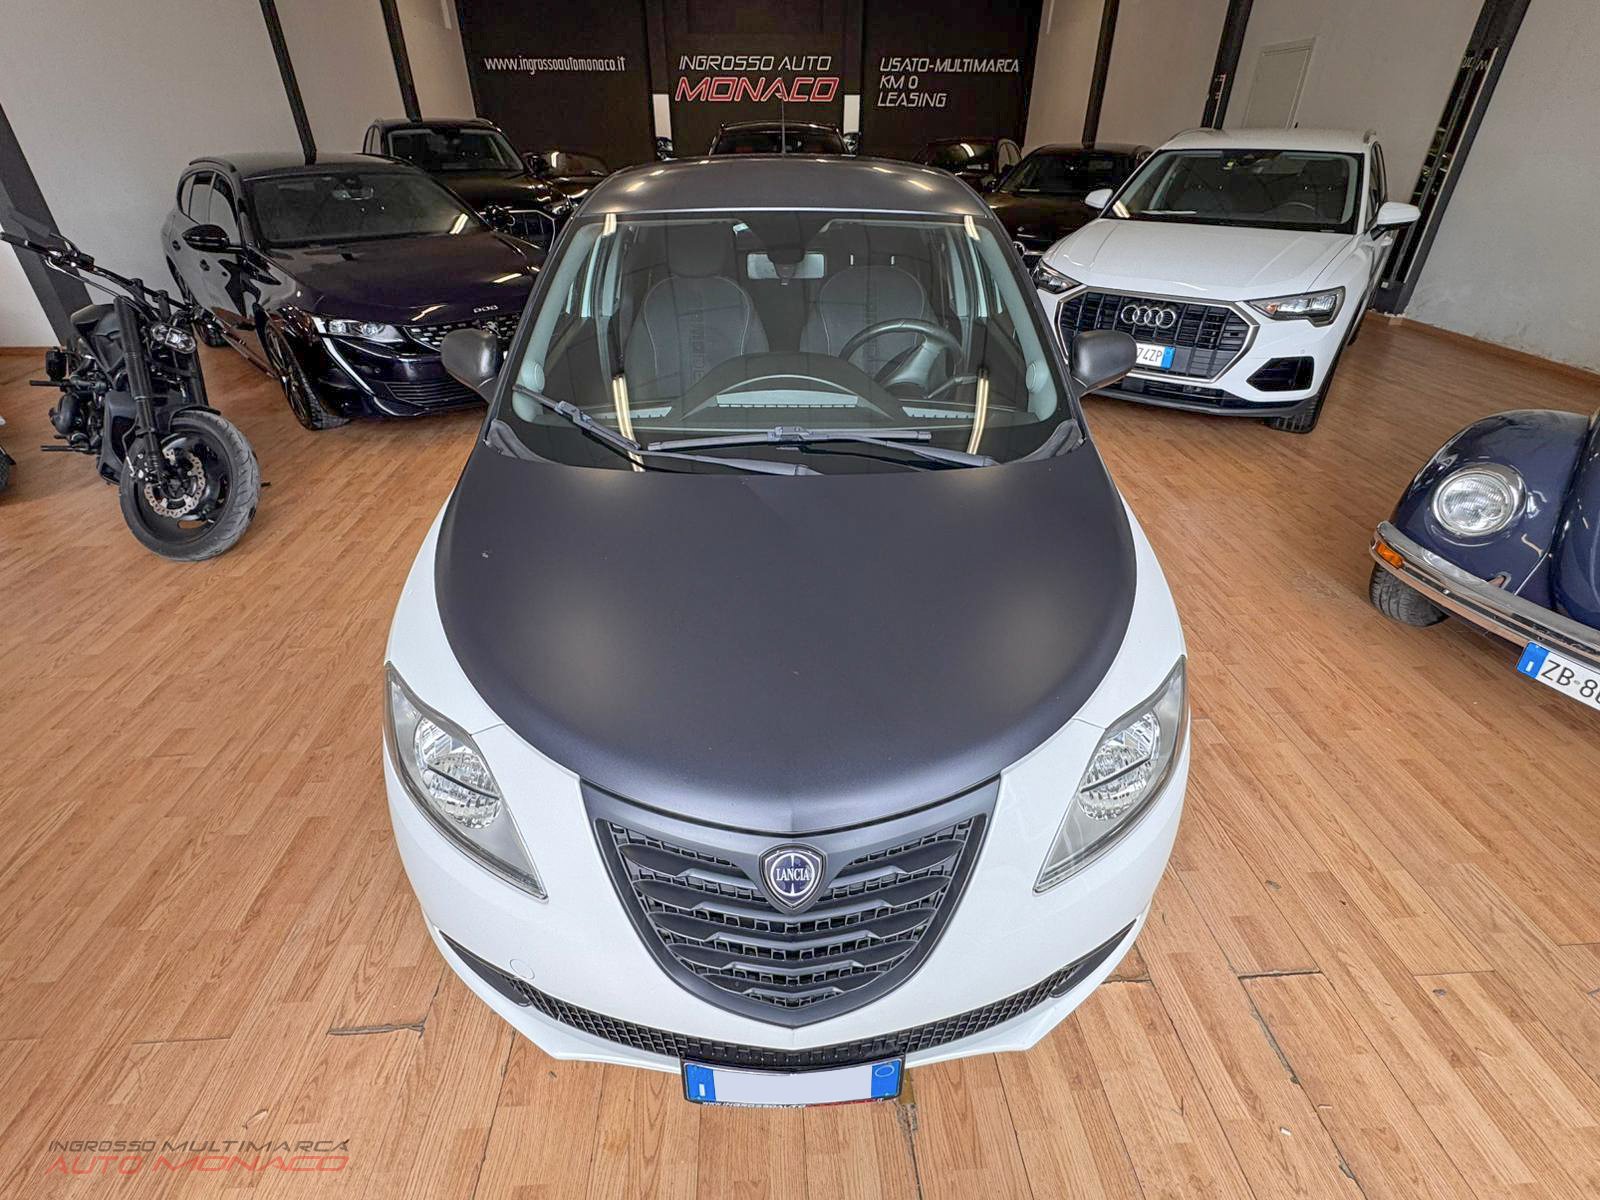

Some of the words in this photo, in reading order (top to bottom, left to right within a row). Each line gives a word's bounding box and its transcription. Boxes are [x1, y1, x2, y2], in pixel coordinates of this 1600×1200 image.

[484, 55, 626, 75] www.ingrossoautomonaco.it
[679, 55, 775, 71] INGROSSO
[778, 55, 832, 71] AUTO
[880, 57, 1019, 73] USATO-MULTIMARCA
[674, 77, 839, 102] MONACO
[880, 75, 904, 89] KM
[877, 91, 947, 107] LEASING
[776, 867, 810, 881] LANCIA
